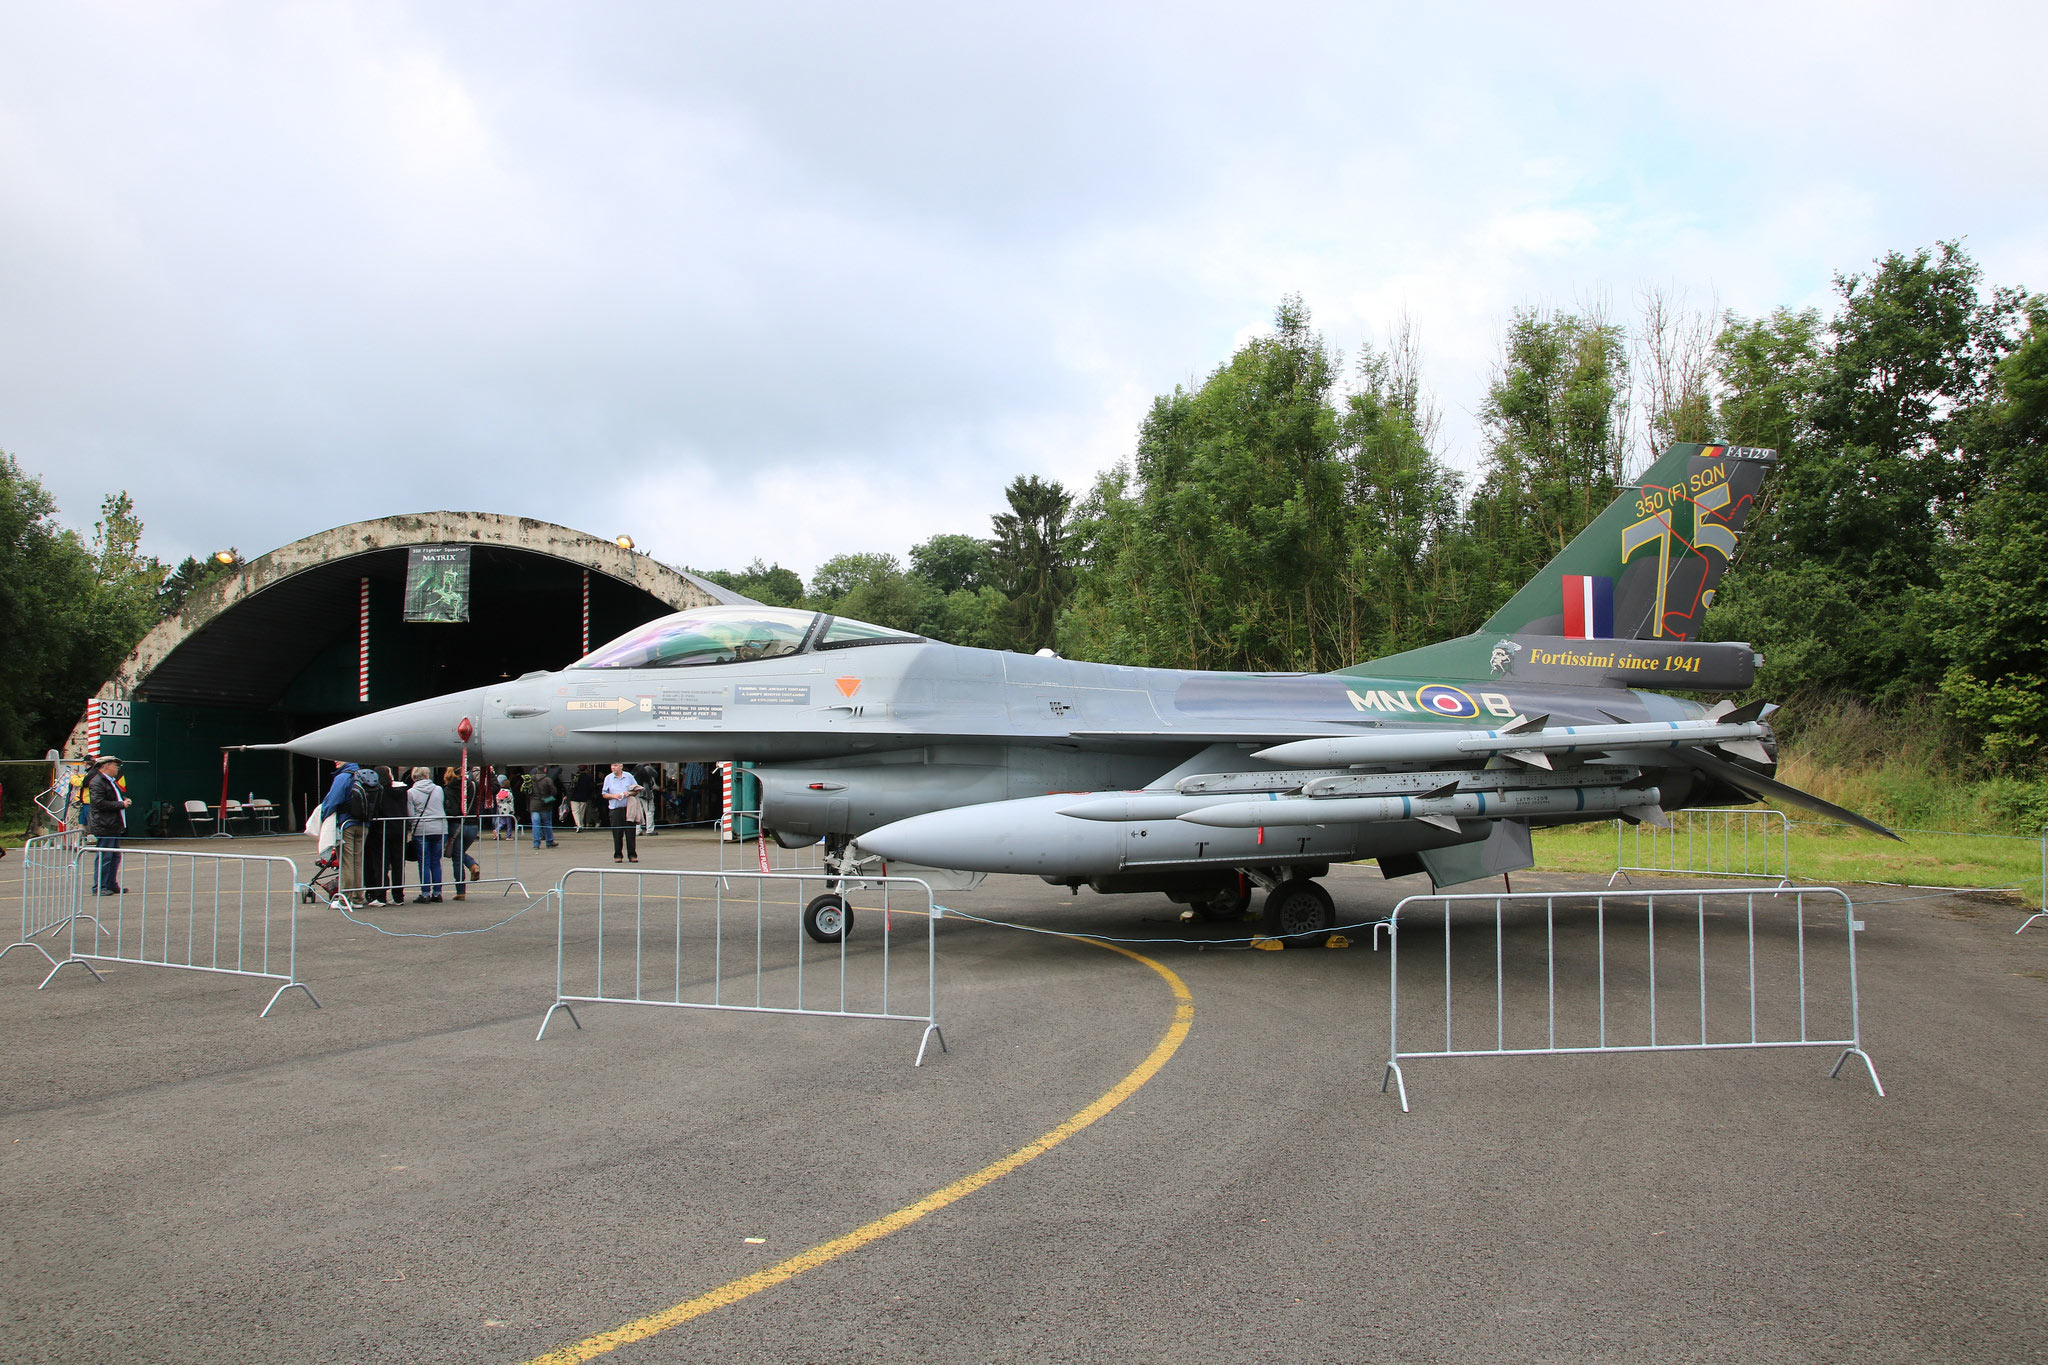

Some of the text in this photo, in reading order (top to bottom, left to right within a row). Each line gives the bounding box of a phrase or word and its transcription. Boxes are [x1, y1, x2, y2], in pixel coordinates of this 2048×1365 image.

[1726, 446, 1769, 459] FA-129
[1635, 462, 1726, 518] 350 (F) SQN
[1529, 648, 1701, 673] Fortissimi since 1941
[1346, 690, 1516, 717] MN B
